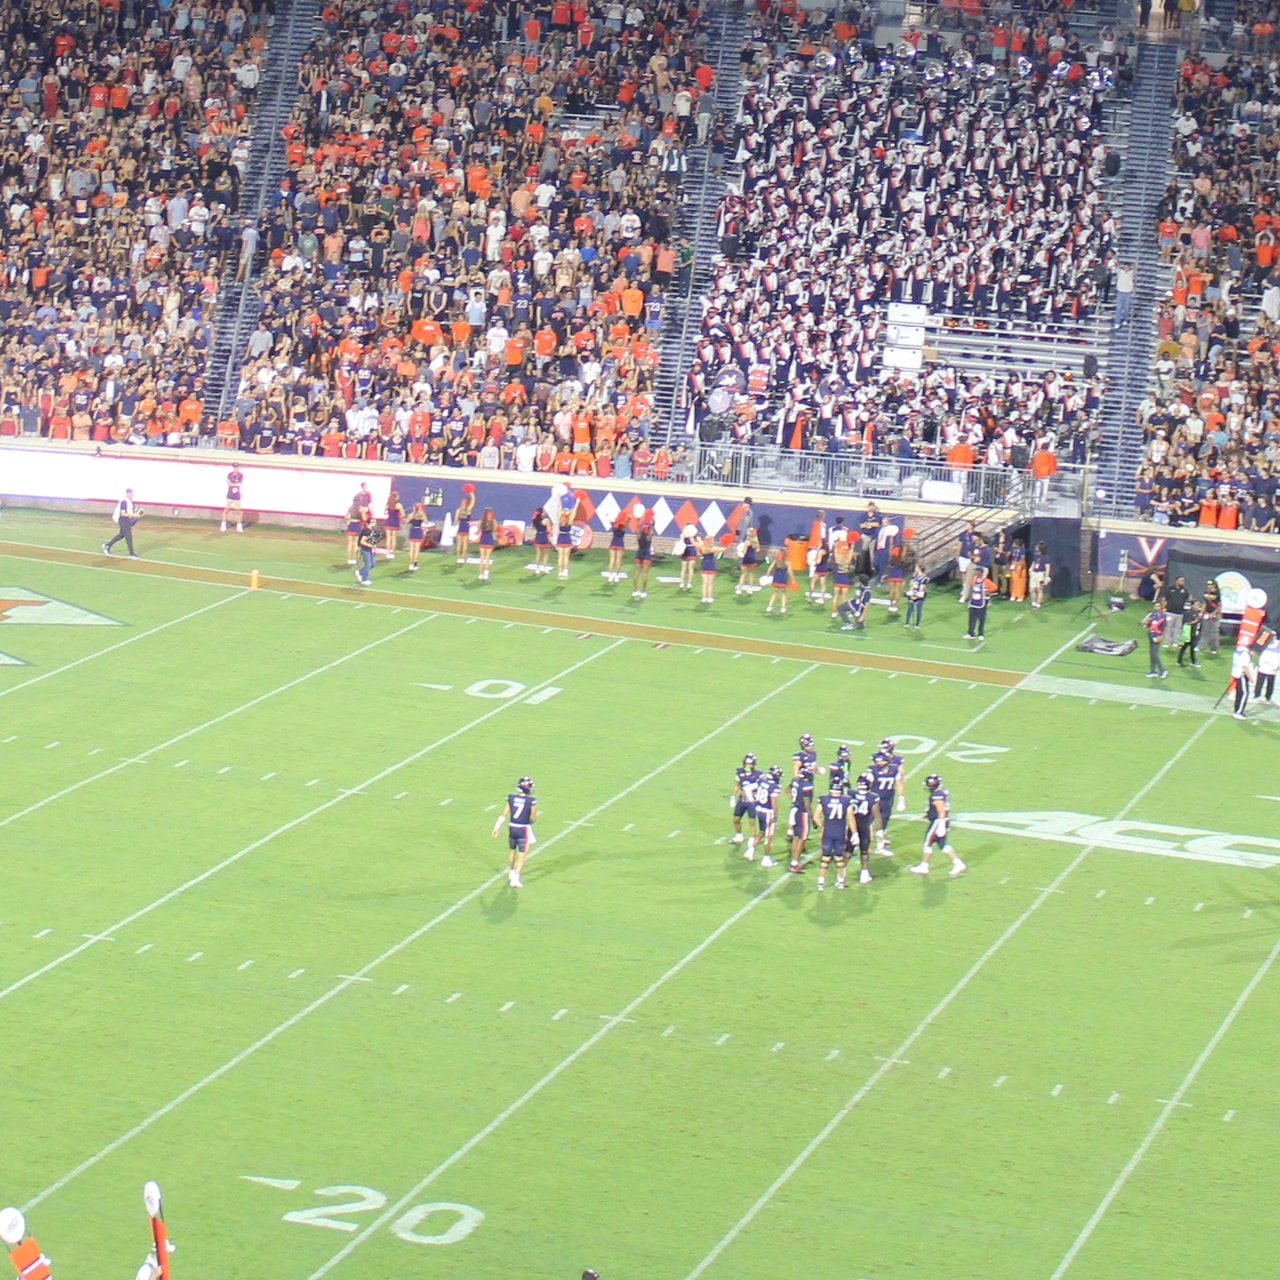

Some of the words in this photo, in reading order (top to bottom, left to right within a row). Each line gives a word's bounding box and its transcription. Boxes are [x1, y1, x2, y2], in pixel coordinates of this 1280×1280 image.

[463, 679, 565, 705] 10
[877, 777, 895, 790] 77
[513, 802, 525, 819] 7
[827, 802, 844, 820] 71
[282, 1185, 486, 1246] 20
